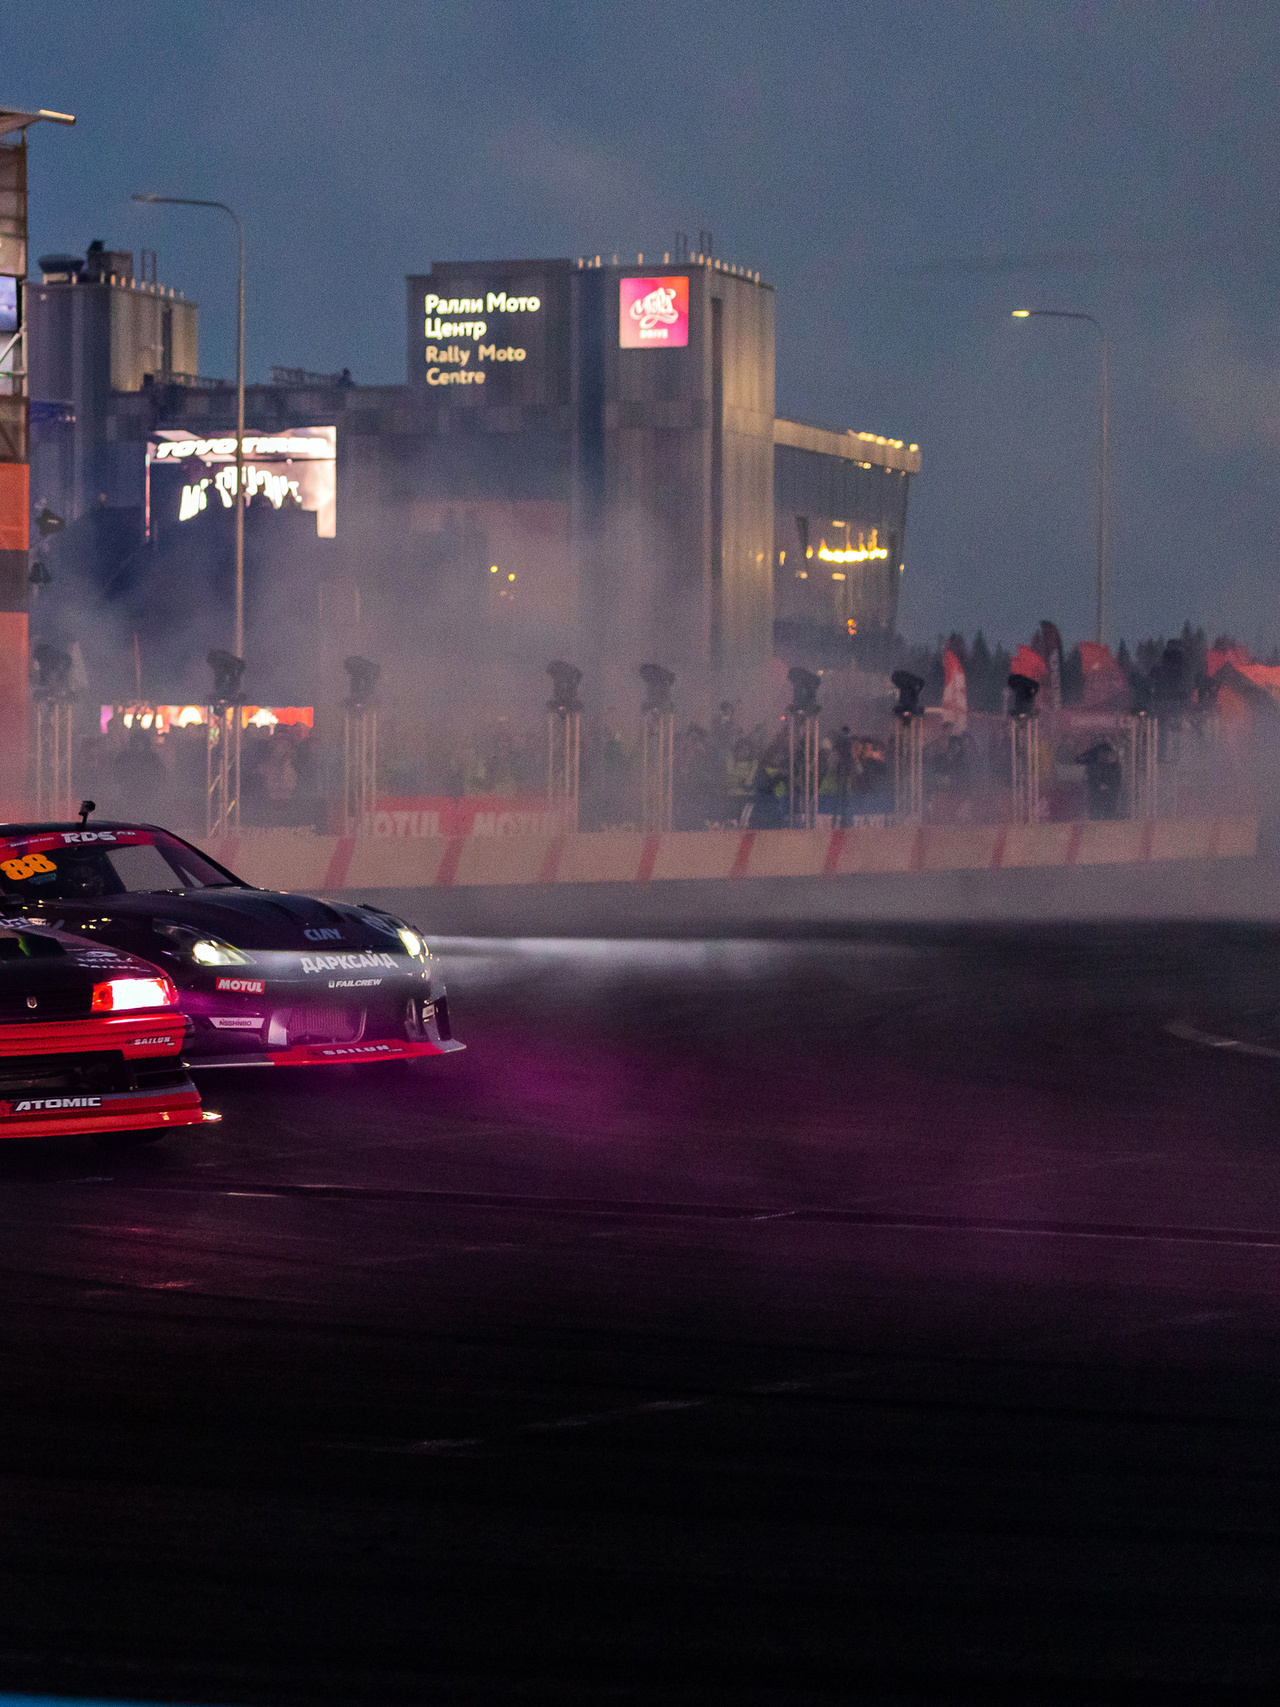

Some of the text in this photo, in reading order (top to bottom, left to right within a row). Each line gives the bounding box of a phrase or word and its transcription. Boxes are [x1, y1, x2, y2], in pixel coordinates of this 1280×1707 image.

[425, 292, 540, 314] Ралли Мото
[425, 318, 487, 340] Центр
[425, 344, 526, 366] Rally Moto
[426, 367, 486, 385] Centre
[156, 438, 238, 459] TOYO
[61, 831, 116, 843] RDS
[0, 853, 57, 880] 88
[300, 950, 399, 974] ДАРКСАЙД
[217, 979, 263, 992] MOTUL
[335, 978, 382, 988] FAILCREW
[134, 1036, 171, 1046] SAILUN
[323, 1044, 389, 1056] SAILUN
[15, 1097, 102, 1111] ATOMIC
